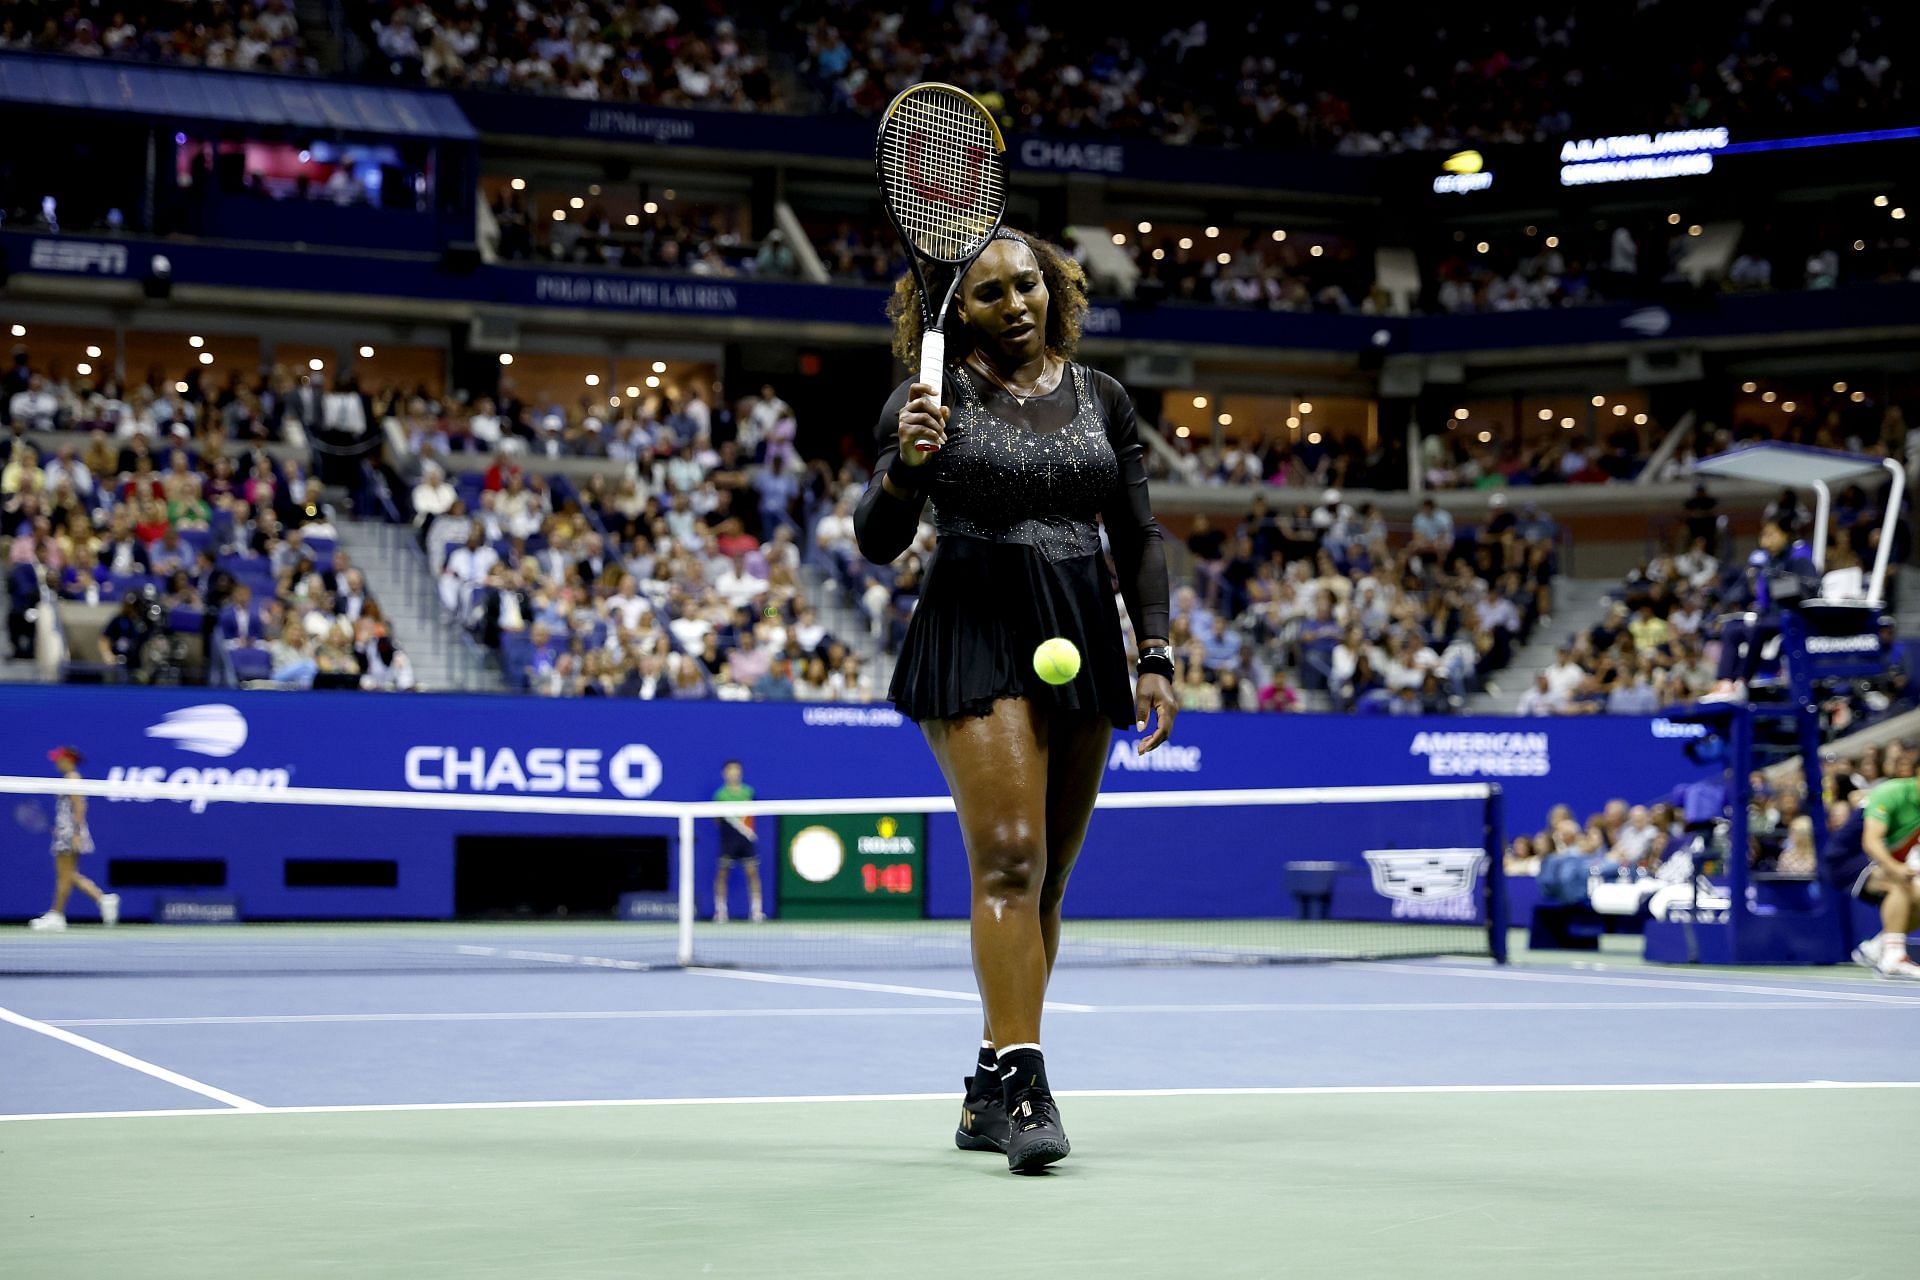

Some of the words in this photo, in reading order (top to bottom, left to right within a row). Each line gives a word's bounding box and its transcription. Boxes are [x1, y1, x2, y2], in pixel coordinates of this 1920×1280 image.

[1021, 139, 1123, 172] CHASE
[30, 239, 128, 274] ESPN
[1409, 732, 1548, 756] AMERICAN
[404, 746, 603, 792] CHASE
[1429, 753, 1550, 776] EXPRESS
